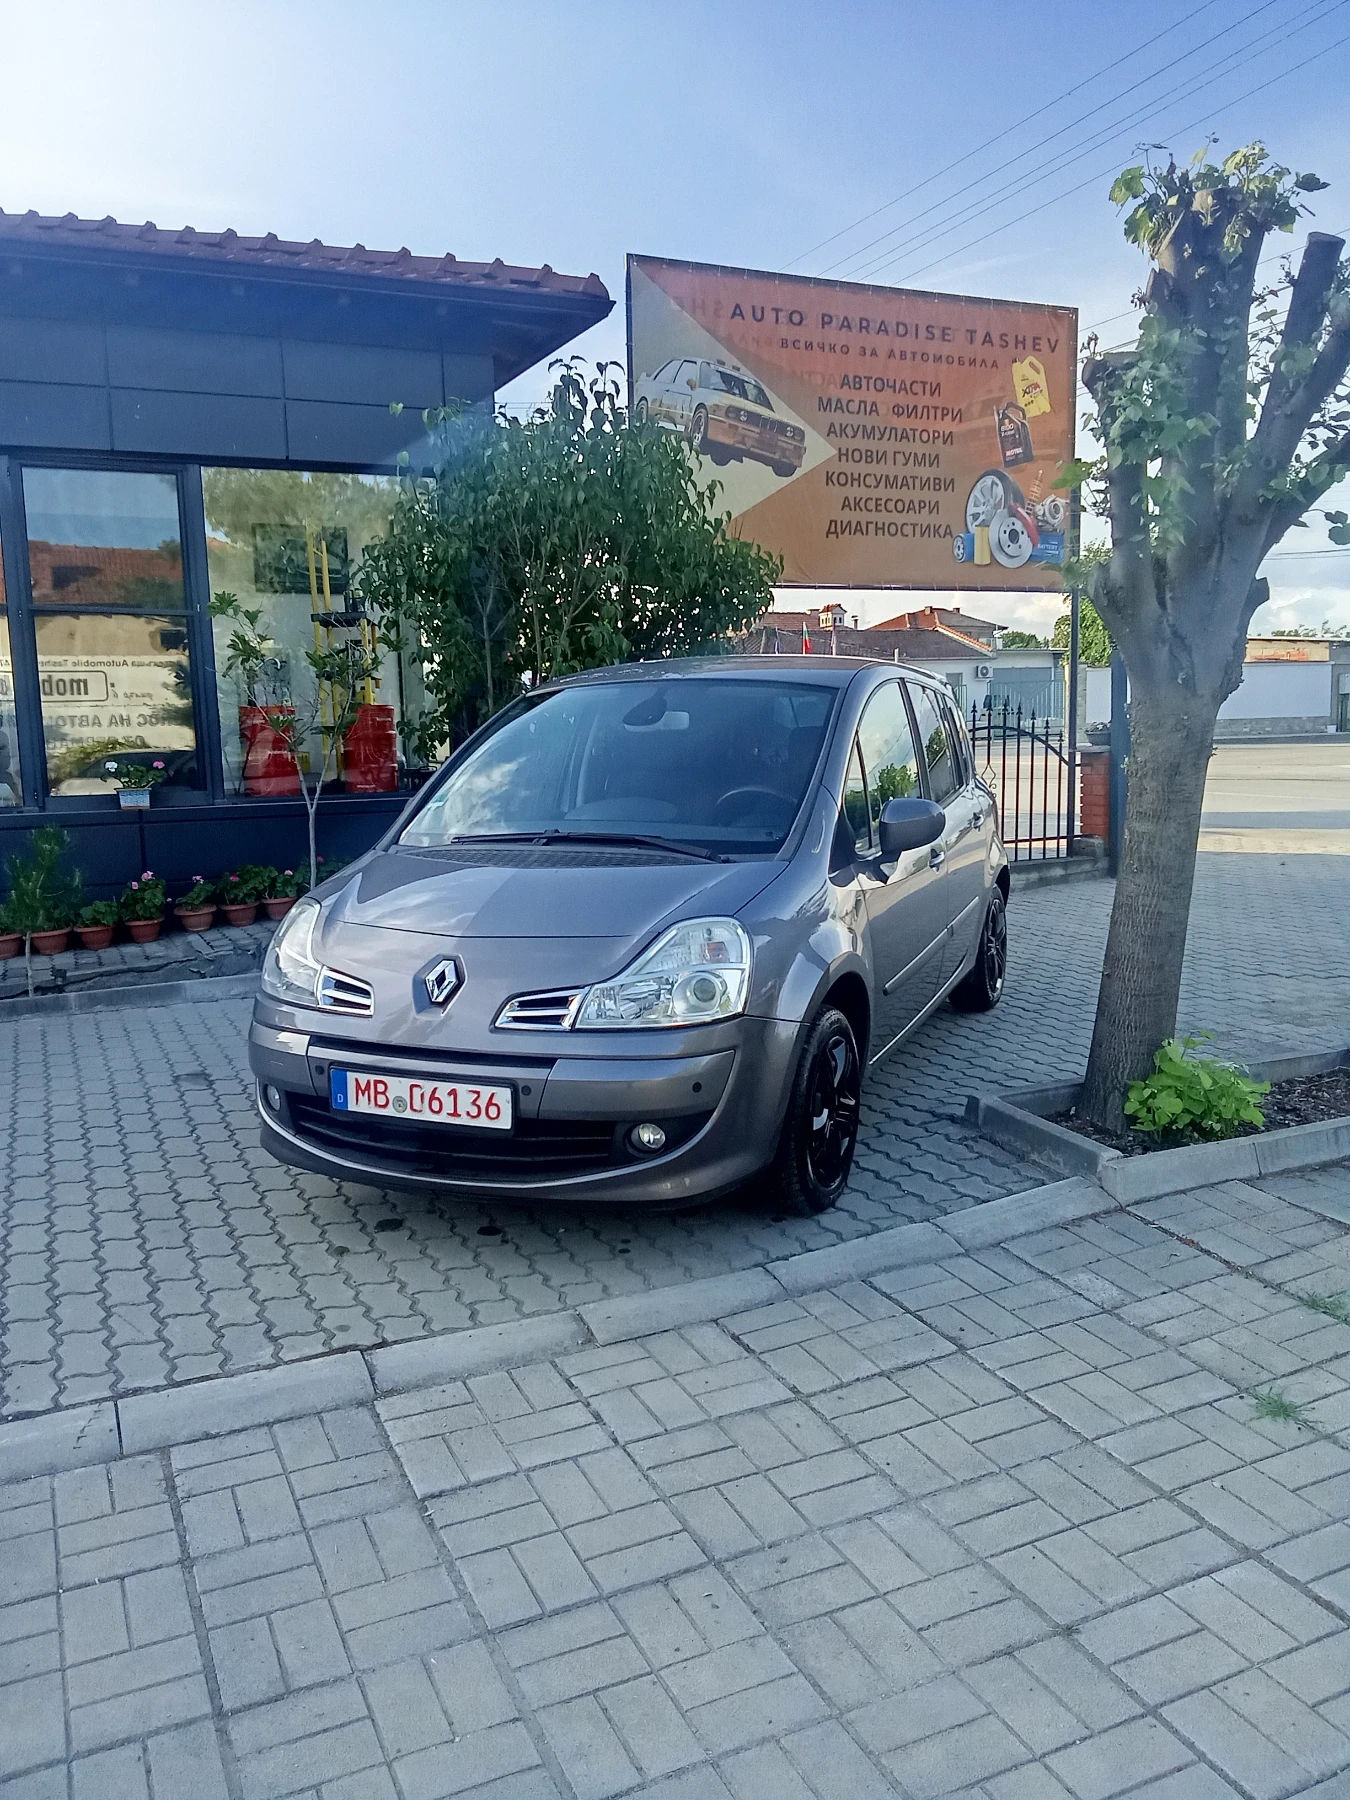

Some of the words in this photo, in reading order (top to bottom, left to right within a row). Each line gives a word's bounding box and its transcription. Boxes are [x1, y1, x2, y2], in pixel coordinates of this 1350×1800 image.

[730, 302, 805, 327] AUTO
[820, 312, 953, 343] PARADISE
[967, 328, 1060, 353] TASHEV
[780, 337, 851, 355] ВСИЧКО
[859, 345, 879, 358] ЗА
[887, 347, 999, 369] АВТОМОБИЛА
[839, 374, 942, 396] АВТОЧАСТИ
[818, 397, 880, 416] МАСЛА
[892, 401, 963, 422] ФИЛТРИ
[827, 422, 954, 446] АКУМУЛАТОРИ
[838, 447, 889, 465] НОВИ
[892, 450, 940, 468] ГУМИ
[825, 471, 955, 492] КОНСУМАТИВИ
[841, 496, 940, 515] АКСЕСОАРИ
[826, 518, 953, 539] ДИАГНОСТИКА
[337, 1094, 344, 1103] D
[354, 1077, 390, 1109] MB
